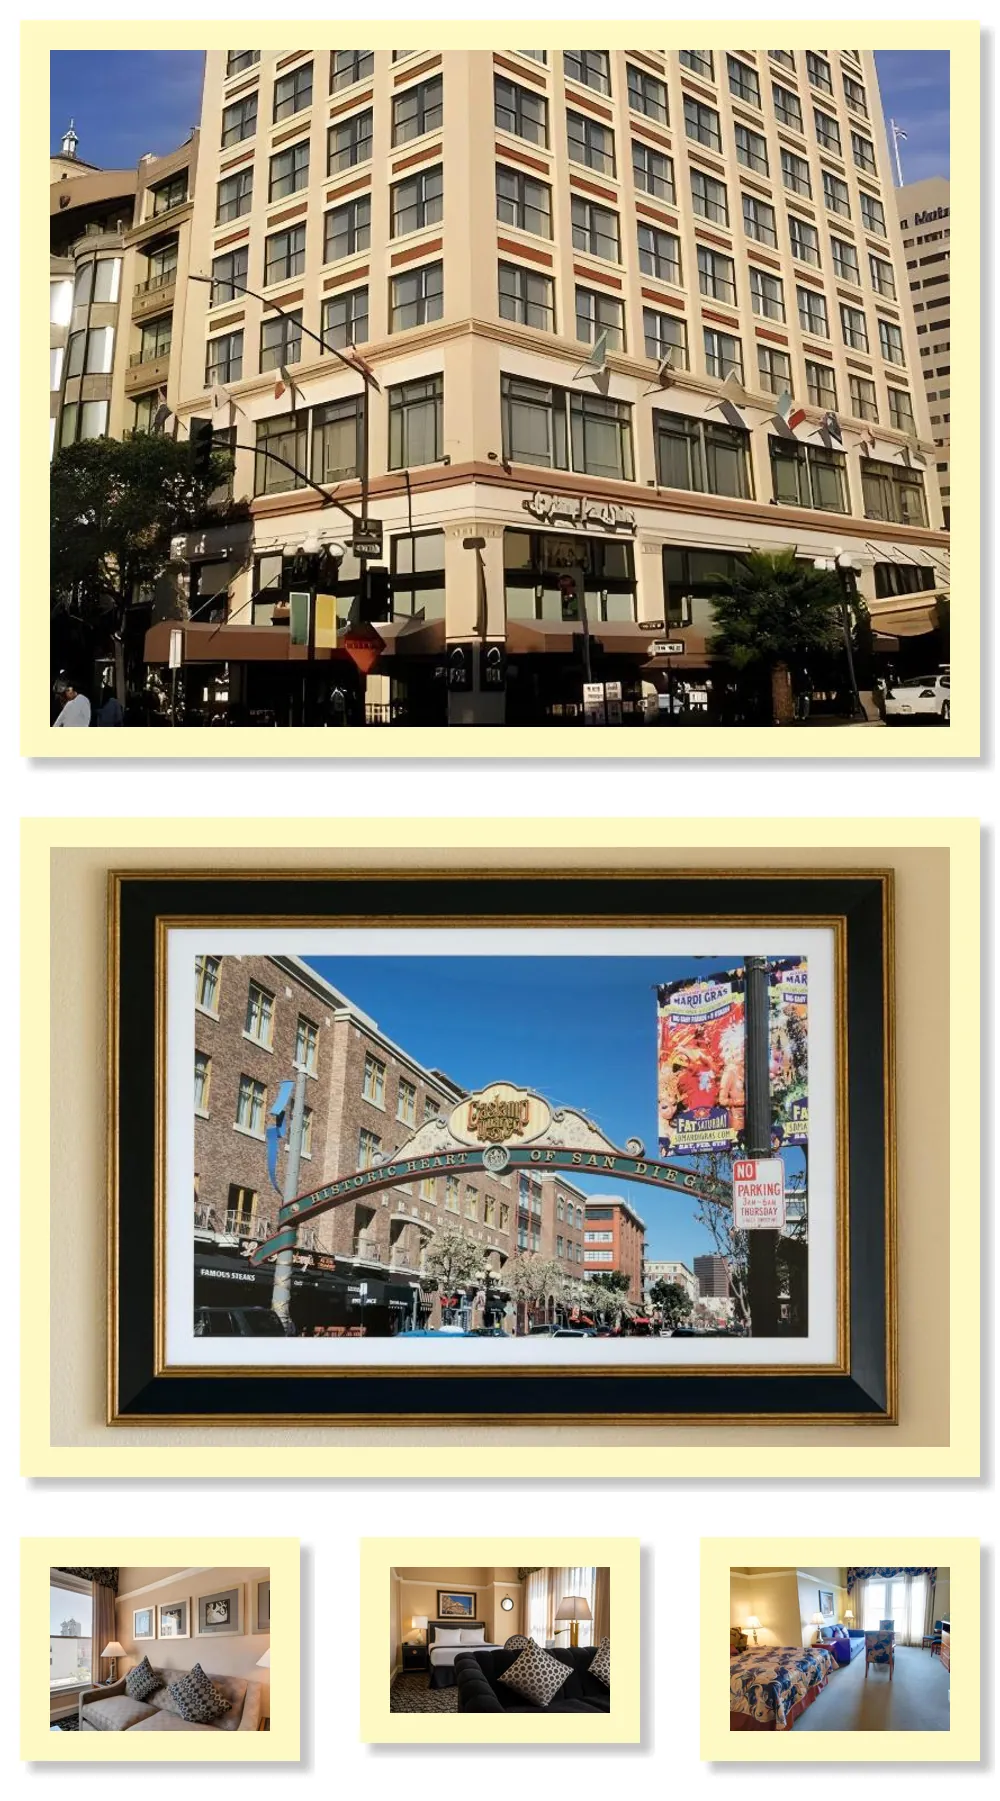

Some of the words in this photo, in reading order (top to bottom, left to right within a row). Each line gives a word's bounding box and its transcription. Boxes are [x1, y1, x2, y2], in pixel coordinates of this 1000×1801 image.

[674, 993, 702, 1009] MARDI
[704, 988, 728, 1002] GRAS
[678, 1118, 697, 1133] FAT
[530, 1149, 556, 1163] OF
[571, 1152, 616, 1169] SAN
[310, 1165, 397, 1205] HISTORIC
[406, 1152, 469, 1172] HEART
[737, 1162, 754, 1179] NO
[737, 1183, 781, 1197] PARKING
[741, 1207, 778, 1216] THURSDAY
[201, 1268, 231, 1279] FAMOUS
[230, 1272, 256, 1281] STEAKS
